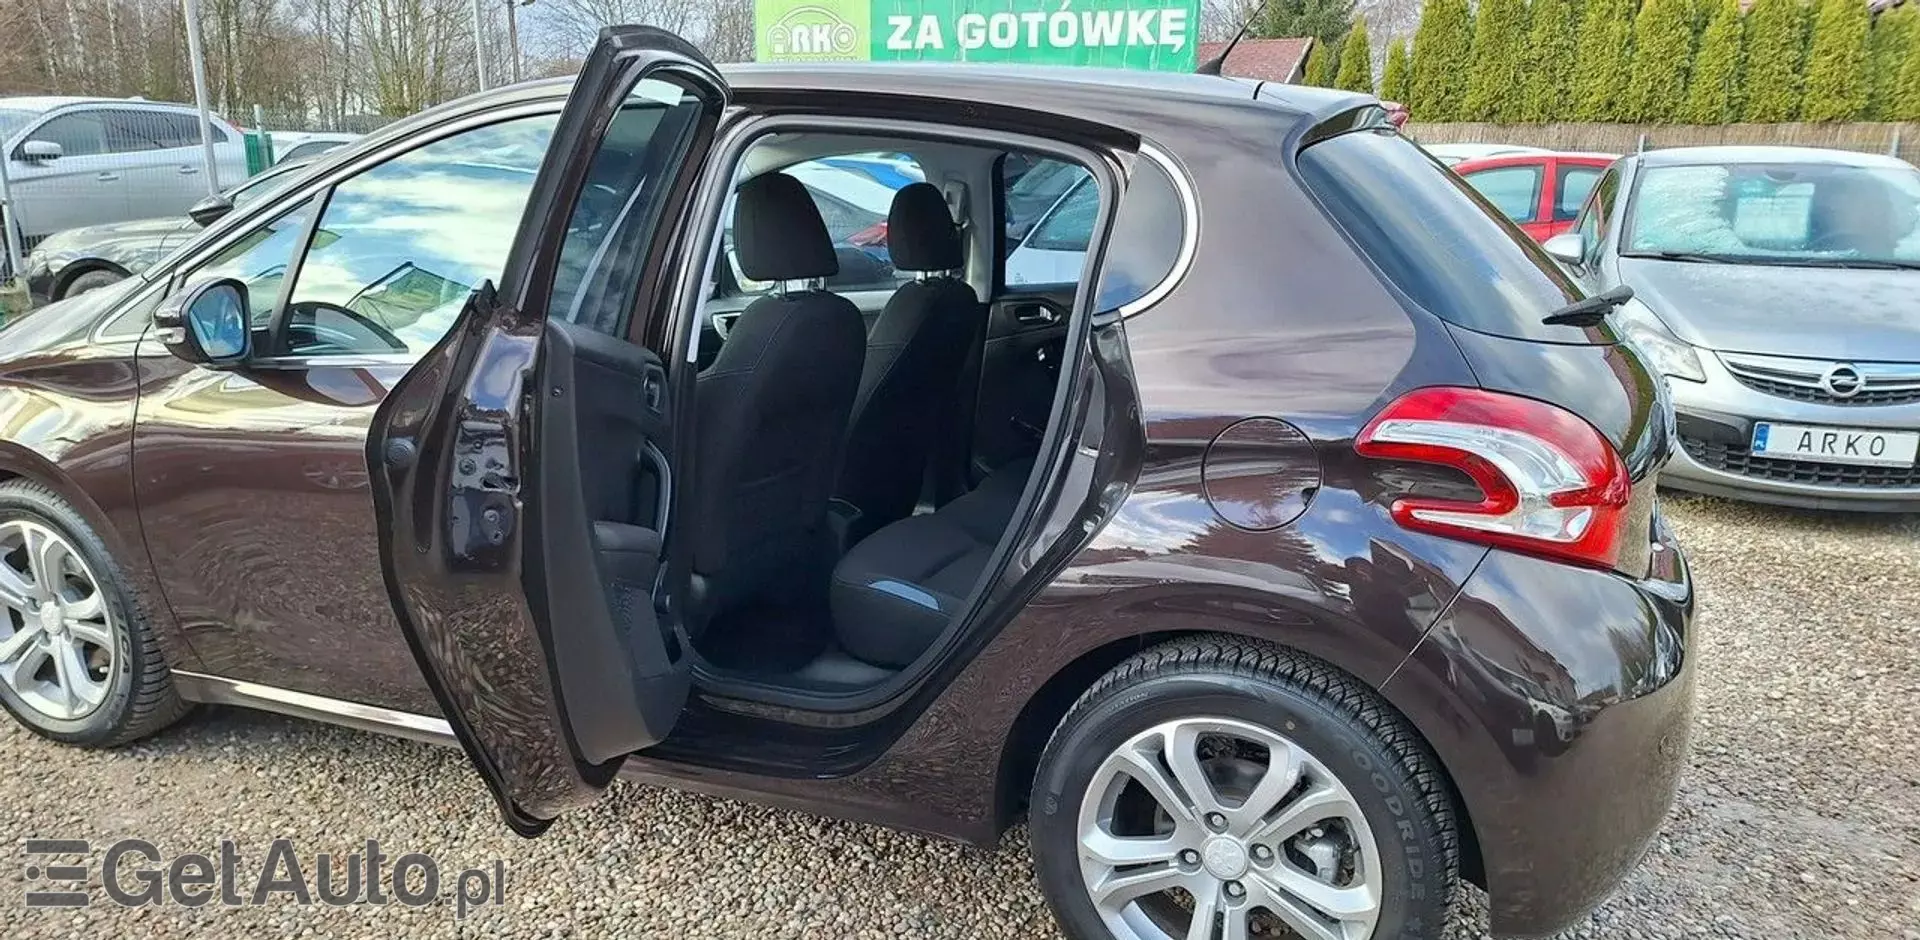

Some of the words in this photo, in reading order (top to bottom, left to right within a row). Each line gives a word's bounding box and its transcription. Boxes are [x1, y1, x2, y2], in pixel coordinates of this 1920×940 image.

[766, 22, 858, 54] ARKO
[887, 15, 944, 49] ZA
[957, 3, 1186, 54] GOTÓWKĘ
[1797, 431, 1885, 457] ARKO
